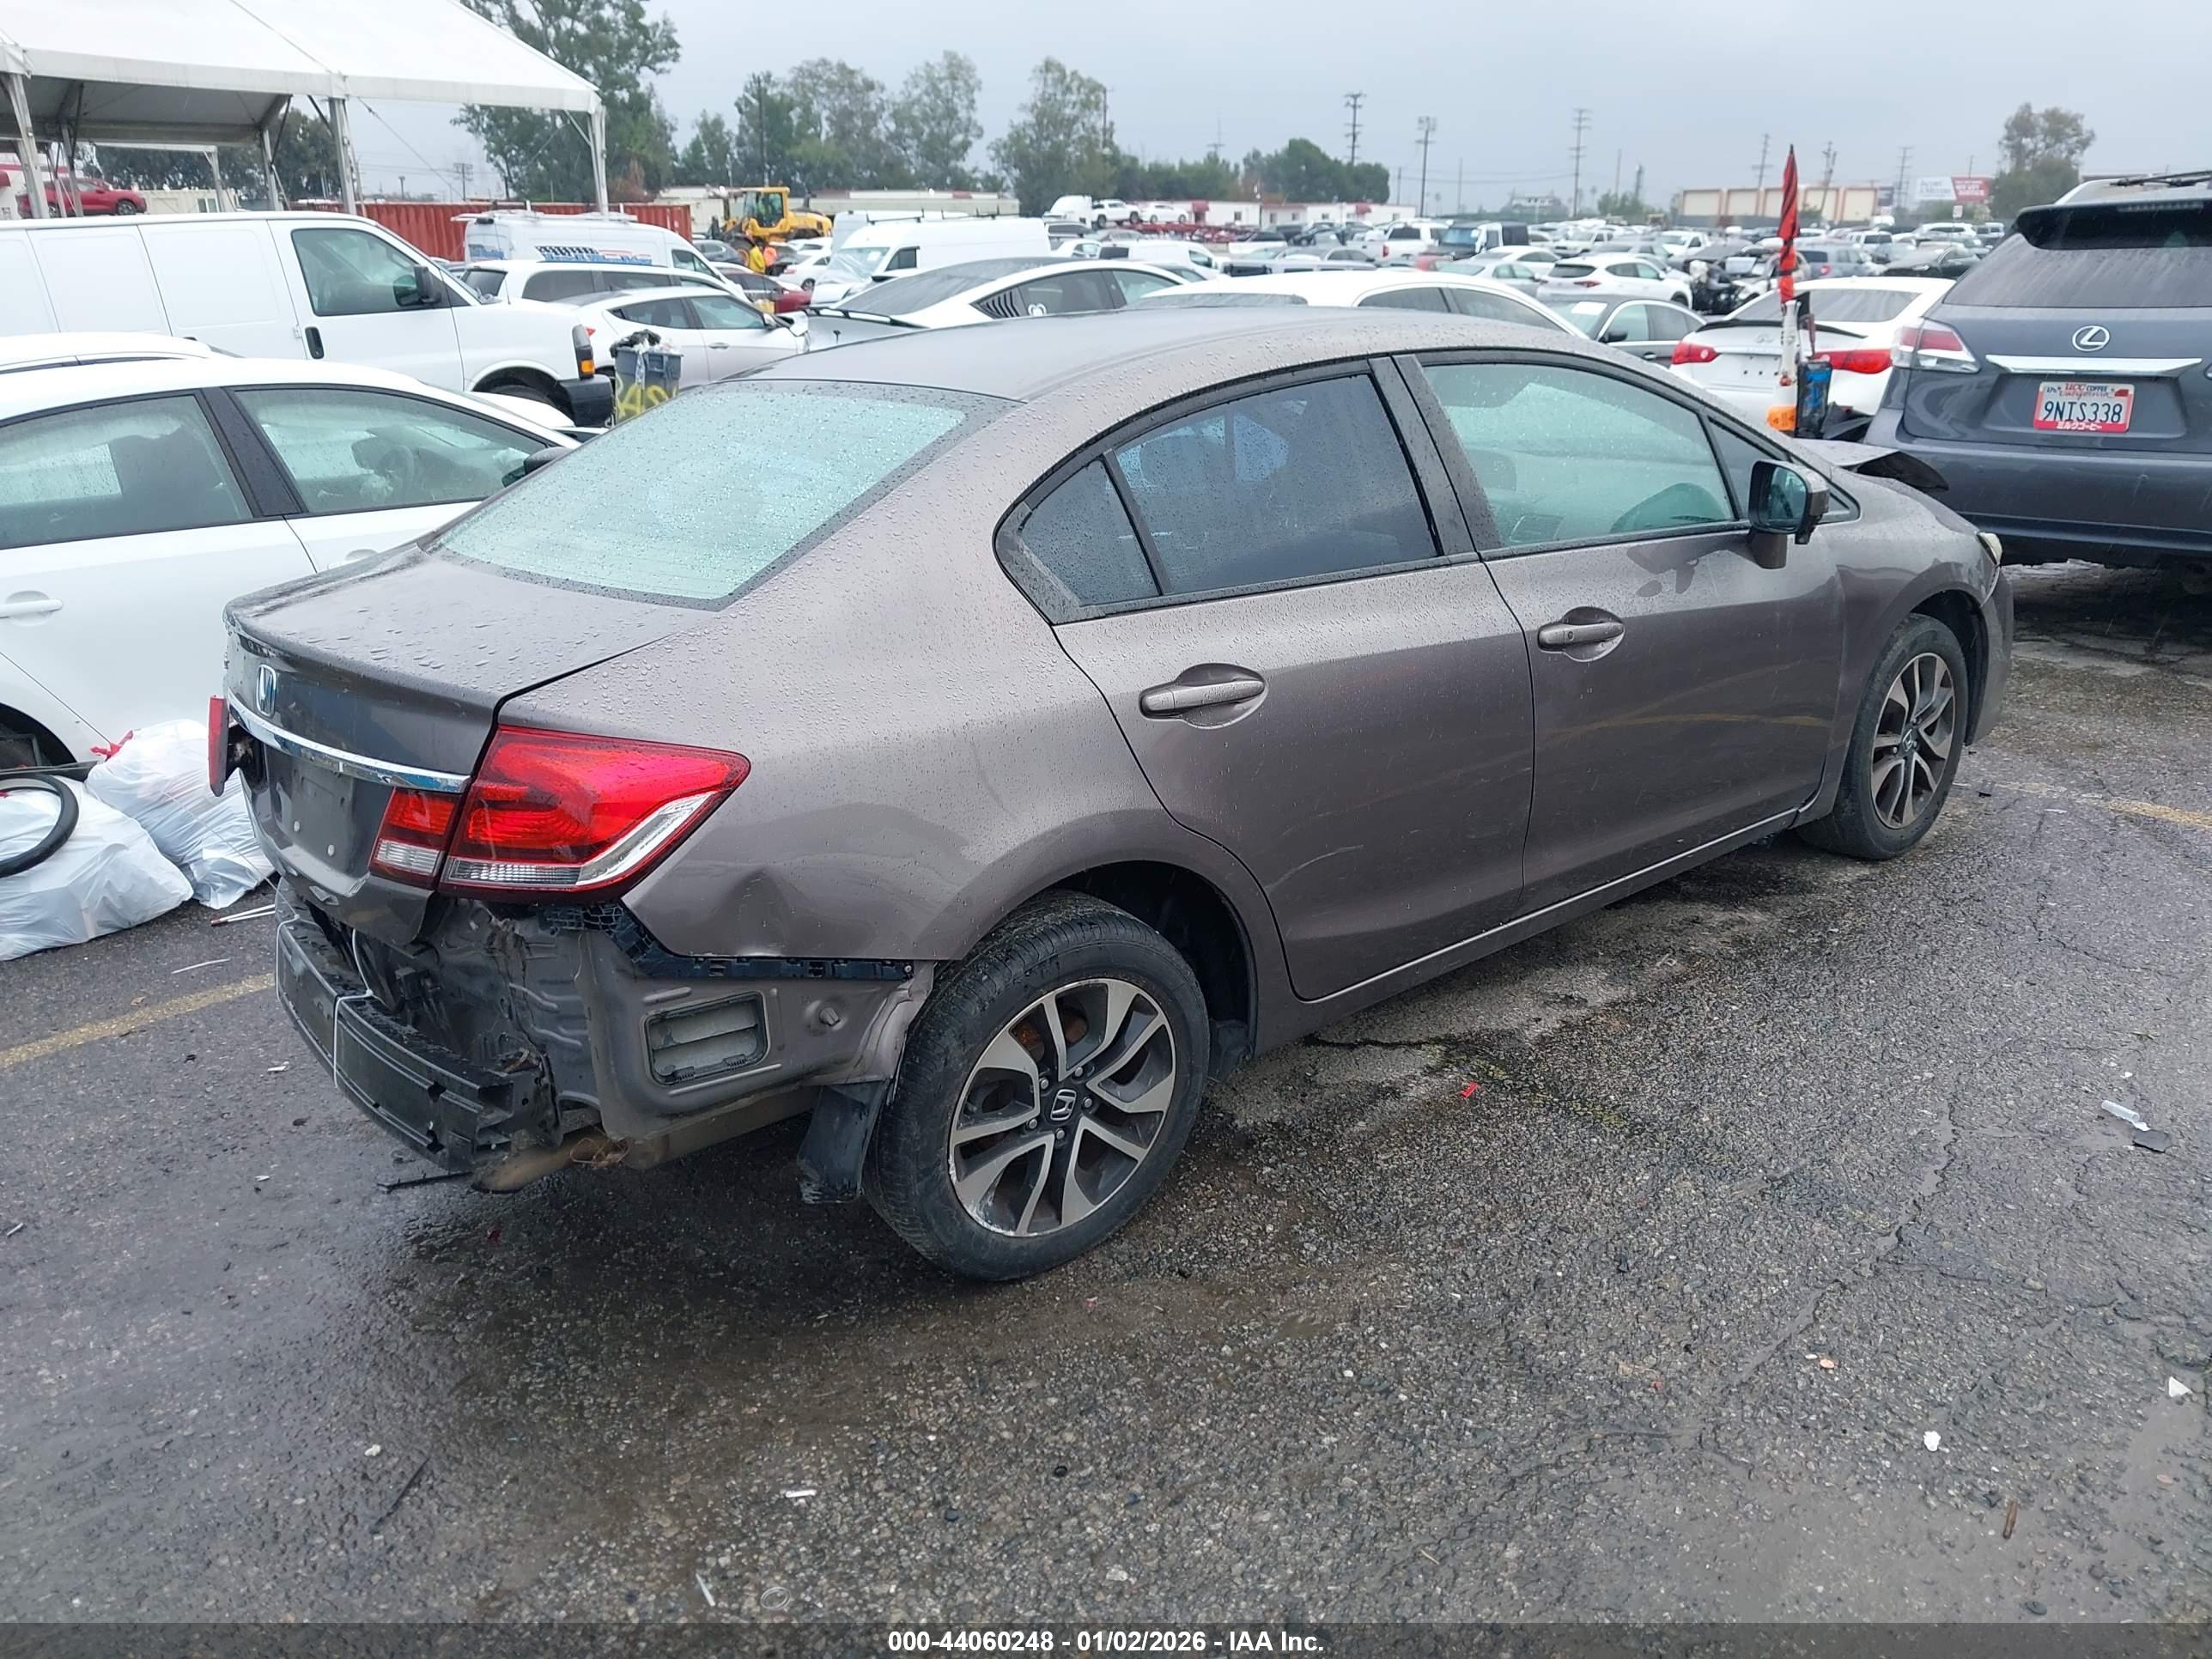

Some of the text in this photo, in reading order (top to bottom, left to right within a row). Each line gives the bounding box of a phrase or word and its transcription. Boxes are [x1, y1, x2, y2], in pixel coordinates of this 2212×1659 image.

[2044, 400, 2123, 423] 9NIS338
[2057, 421, 2102, 431] ミルクコーヒー
